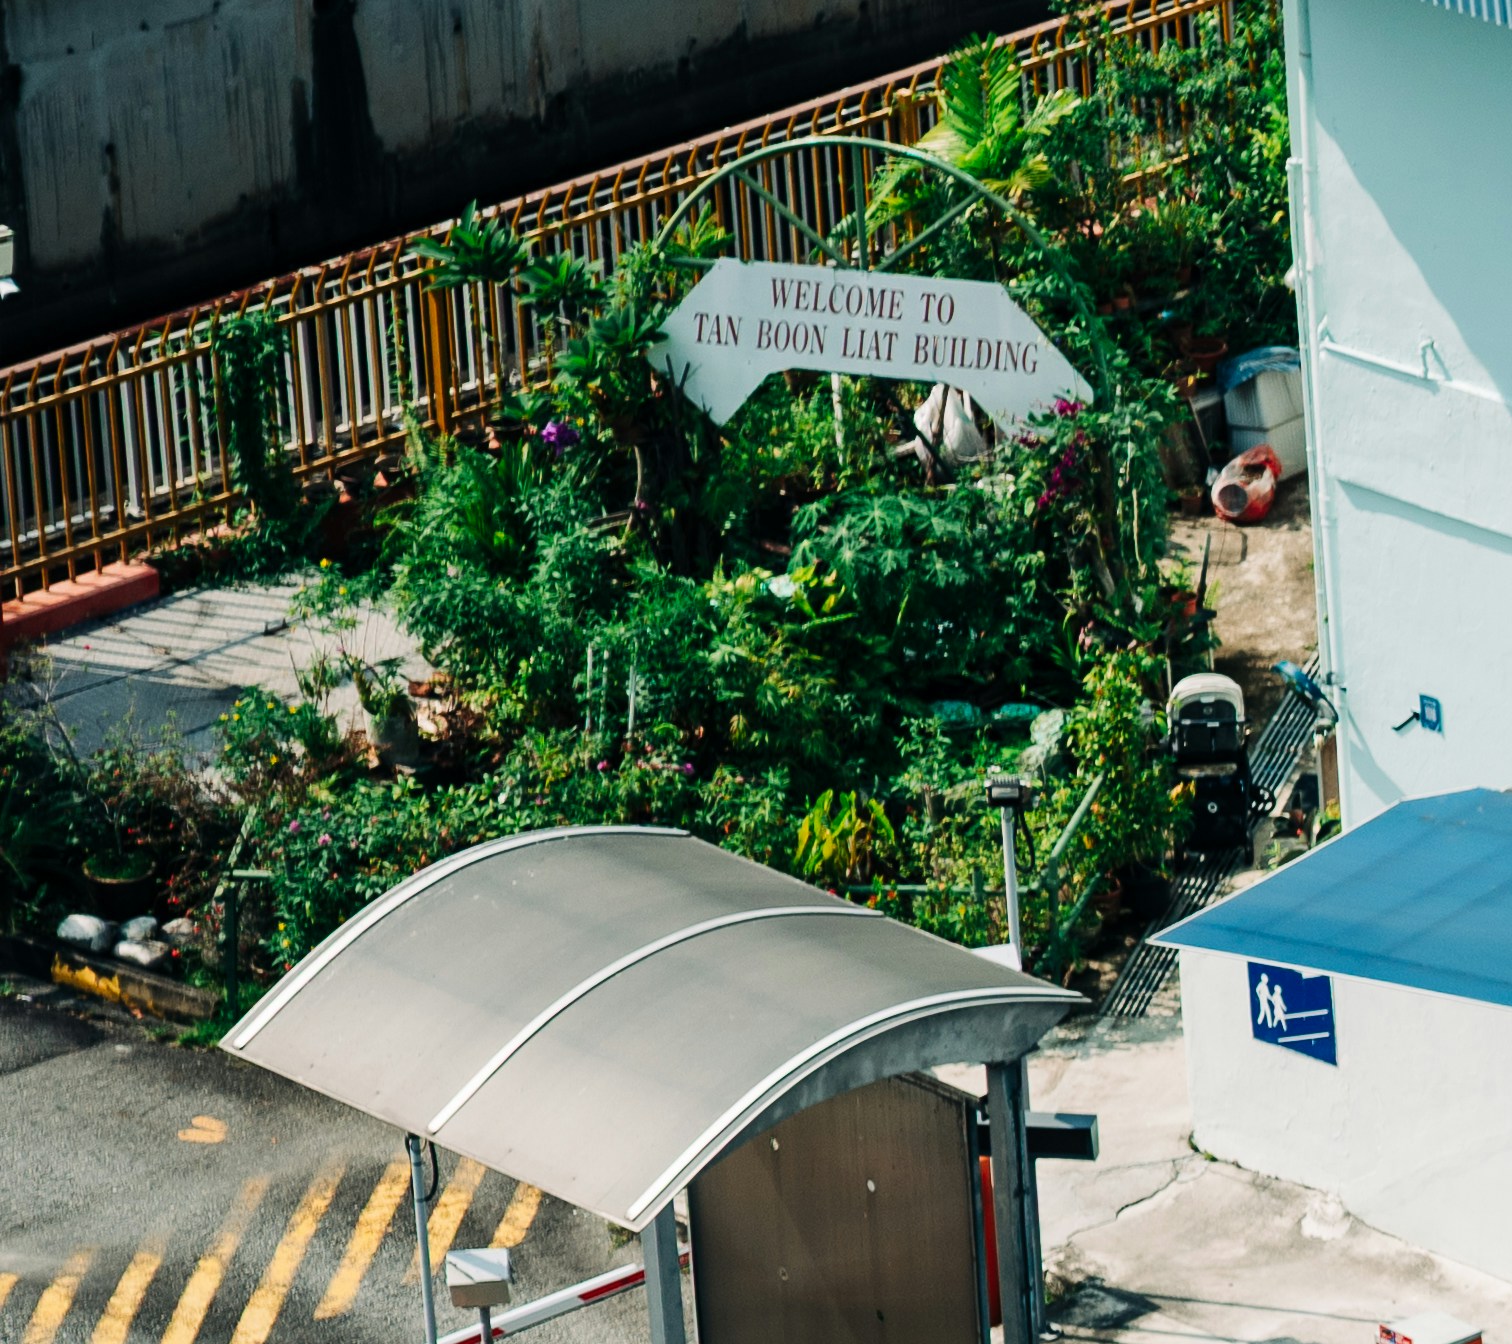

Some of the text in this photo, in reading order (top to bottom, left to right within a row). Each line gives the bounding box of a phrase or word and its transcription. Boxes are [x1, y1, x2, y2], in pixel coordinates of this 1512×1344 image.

[771, 277, 956, 326] WELCOME TO
[693, 312, 1039, 376] TAN BOON LIAT BUILDING
